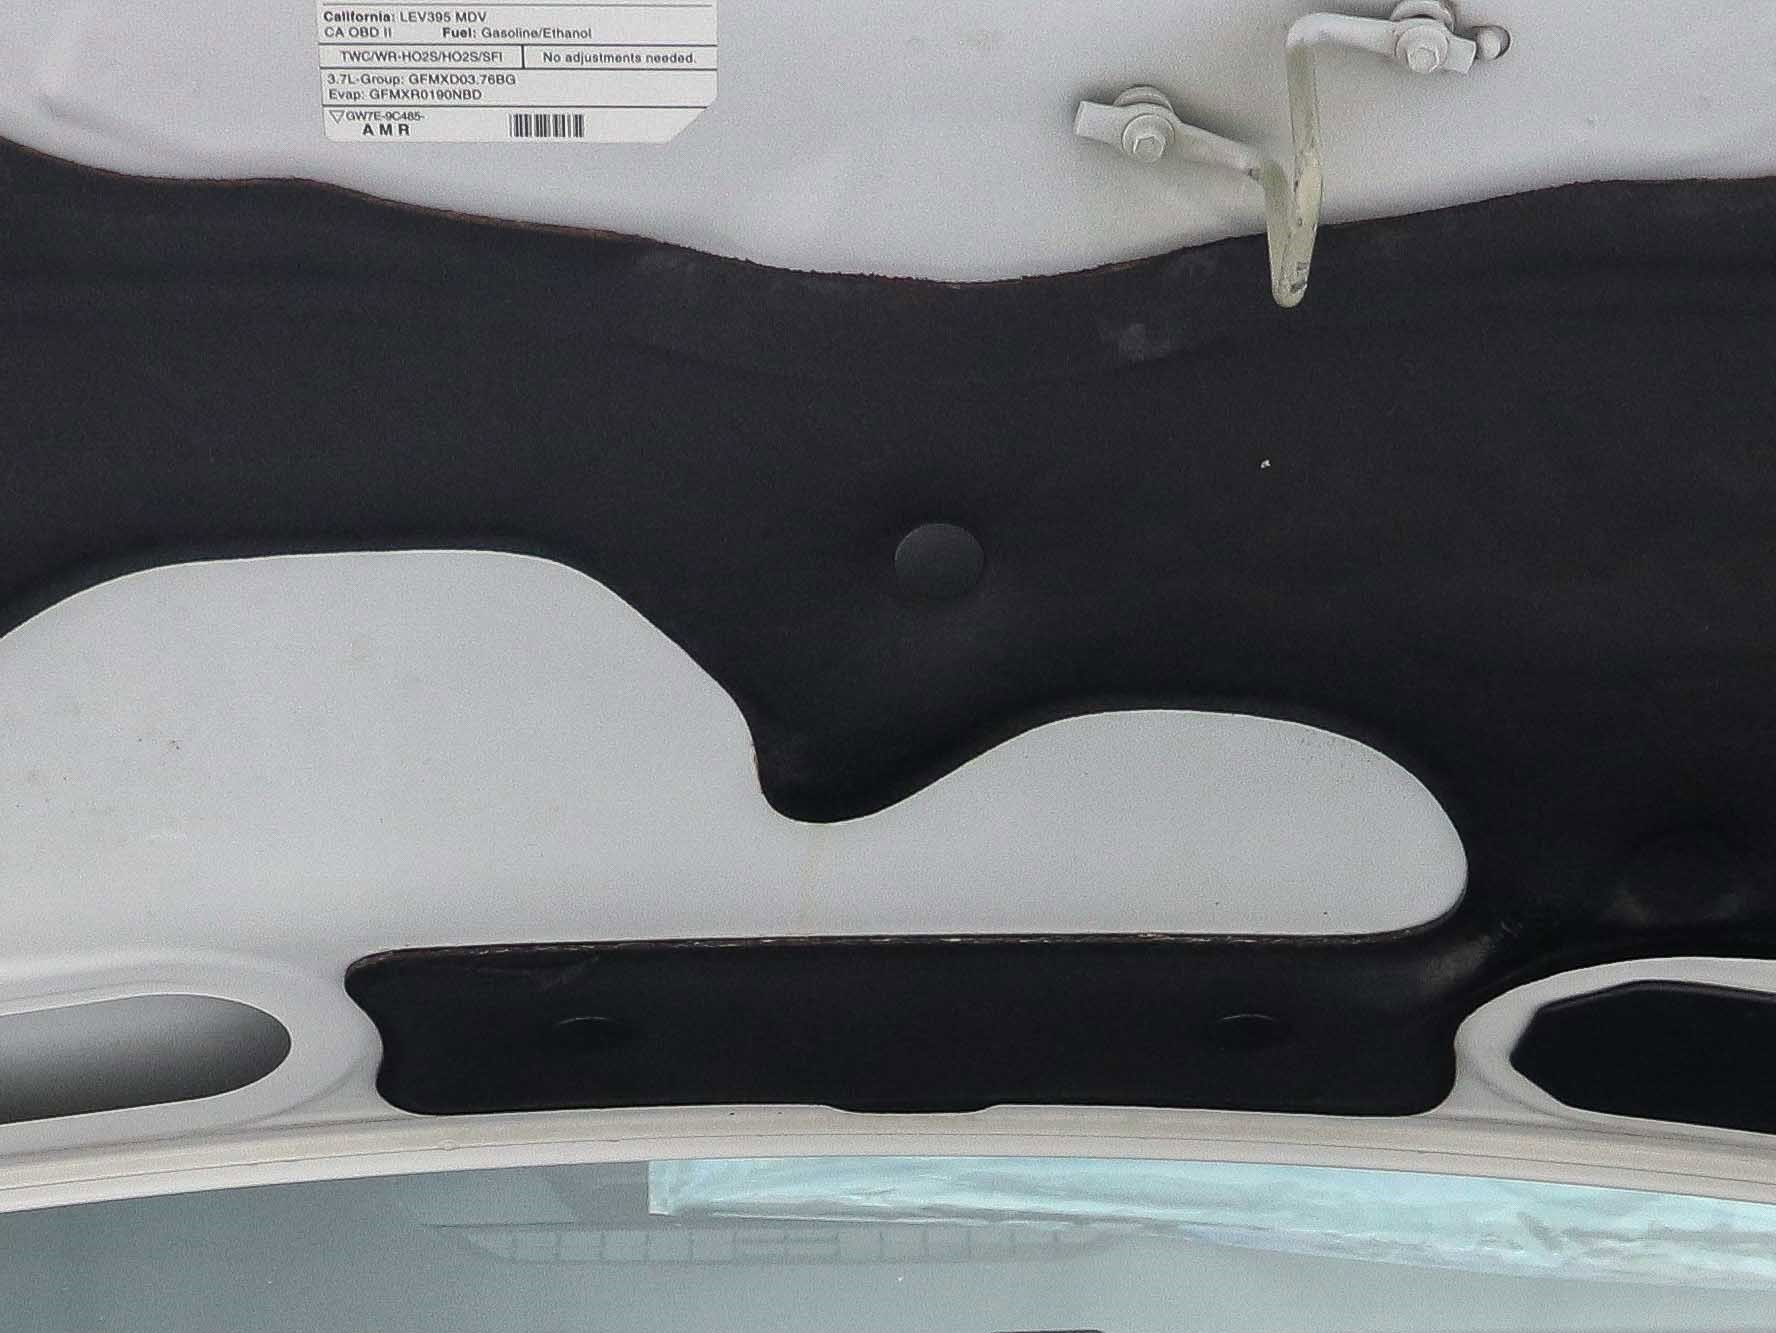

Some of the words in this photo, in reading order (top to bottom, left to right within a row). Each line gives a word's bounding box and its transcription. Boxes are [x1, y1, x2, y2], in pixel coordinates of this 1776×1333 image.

[323, 11, 395, 23] California:
[400, 12, 451, 23] LEV395
[456, 11, 488, 23] MDV
[325, 27, 344, 38] CA
[348, 27, 379, 38] OBD
[383, 27, 392, 38] II
[442, 27, 476, 38] Fuel:
[481, 27, 592, 39] Gasoline/Ethanol
[543, 52, 561, 63] No
[565, 53, 642, 66] adjustments
[646, 53, 696, 64] needed.
[327, 74, 404, 86] 3.7L-Group:
[328, 89, 365, 101] Evap:
